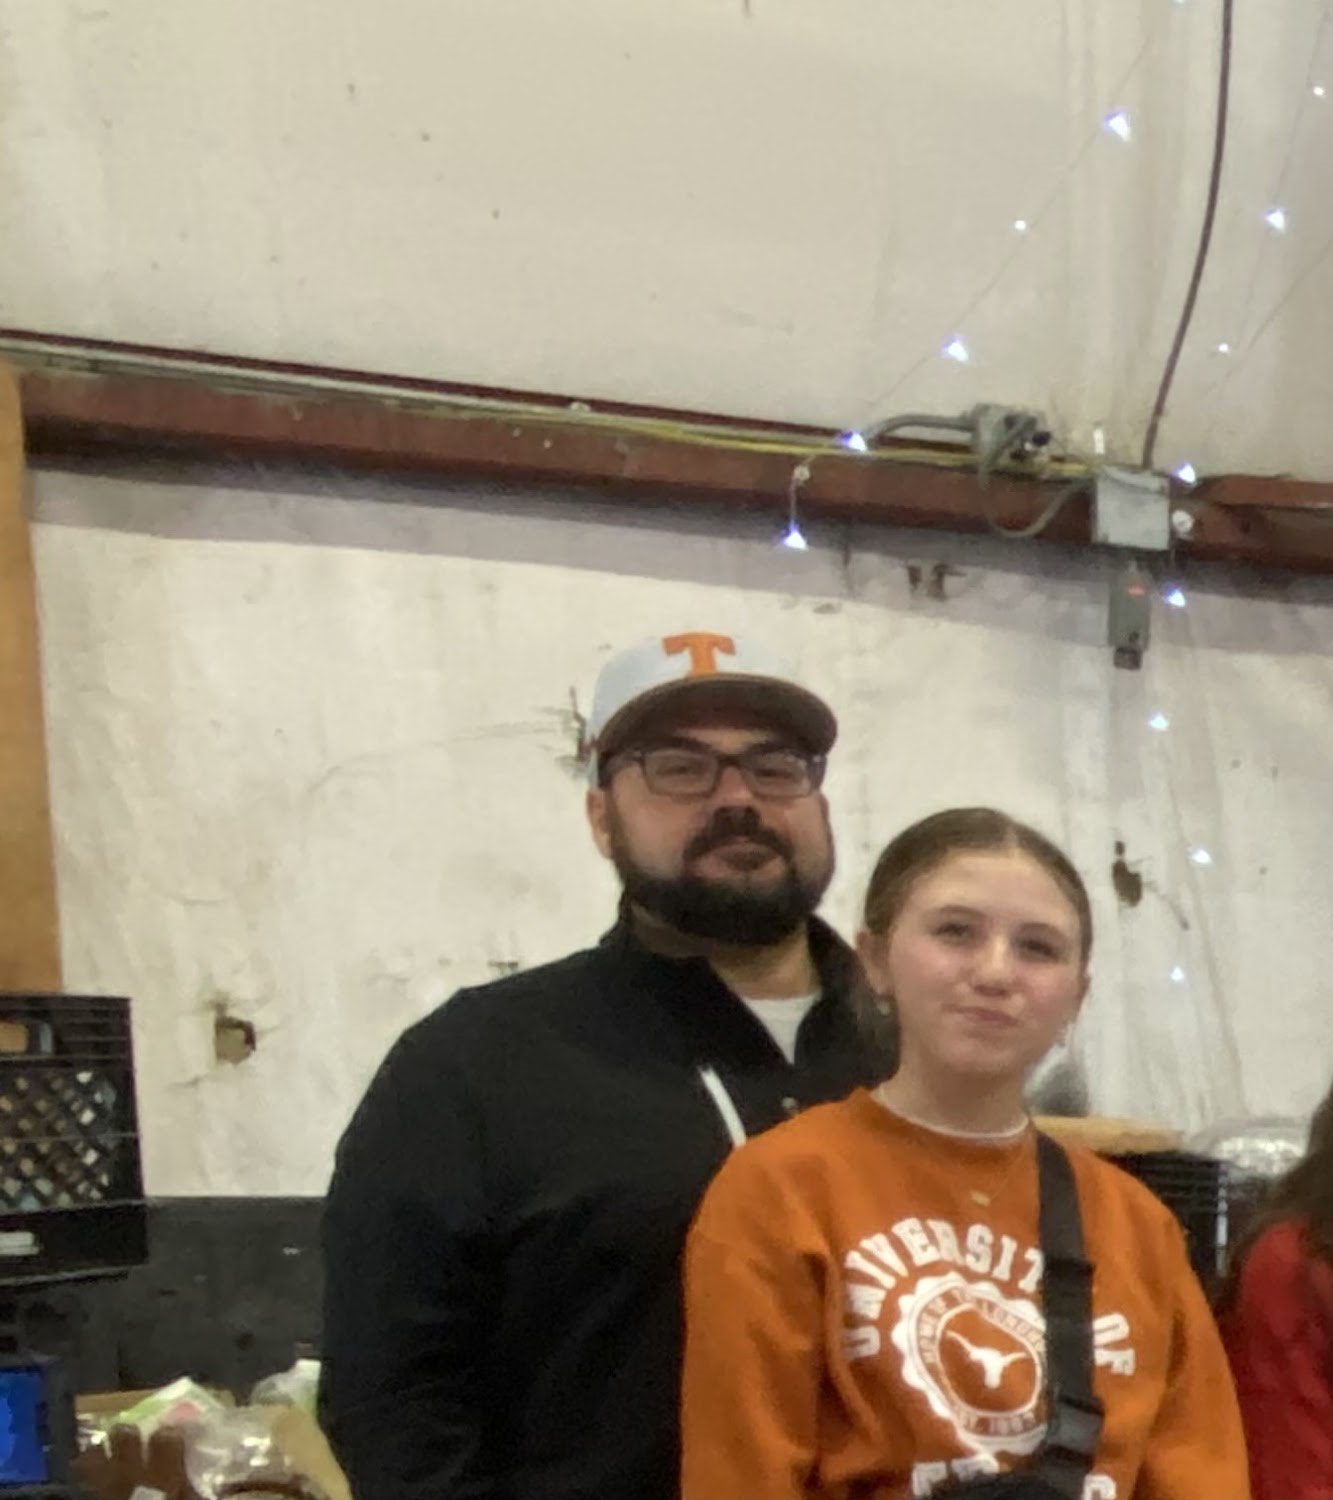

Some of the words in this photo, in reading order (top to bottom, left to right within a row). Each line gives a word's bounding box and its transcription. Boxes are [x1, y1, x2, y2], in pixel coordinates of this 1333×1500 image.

[662, 631, 735, 677] T
[845, 1217, 1045, 1360] UNIVERSIT
[1093, 1313, 1136, 1376] OF
